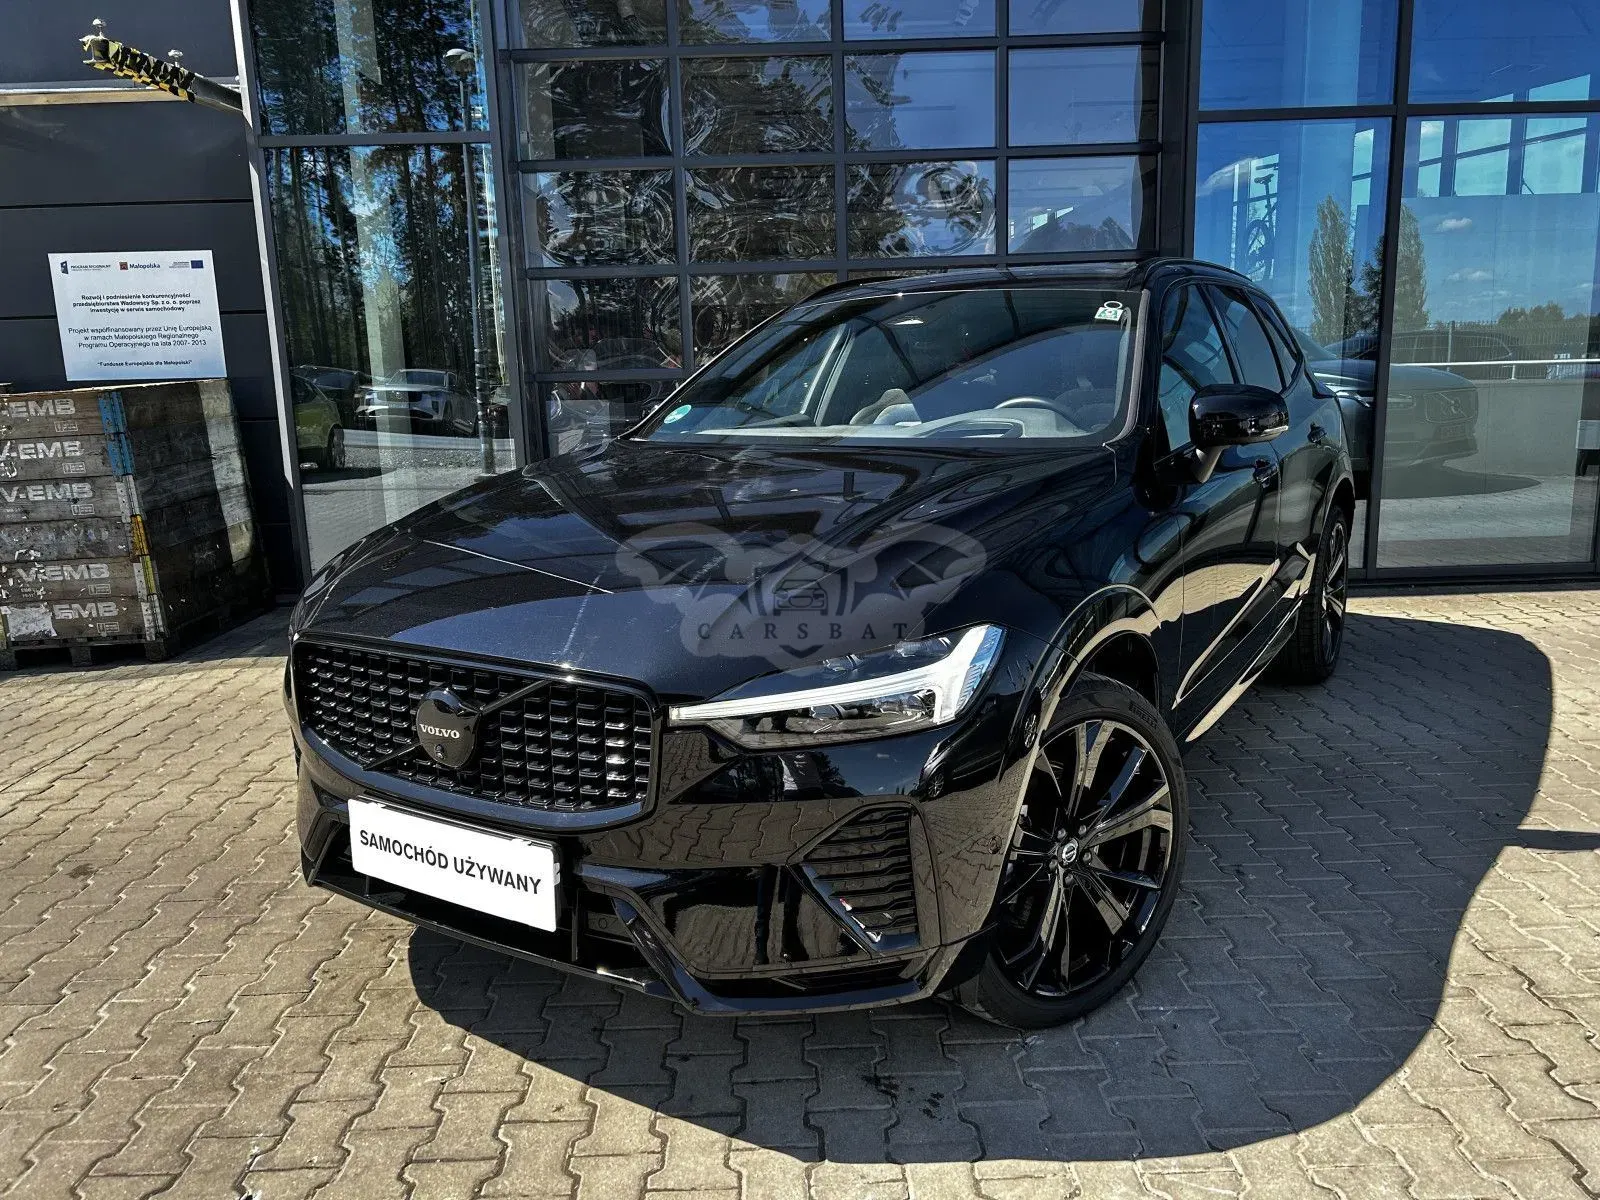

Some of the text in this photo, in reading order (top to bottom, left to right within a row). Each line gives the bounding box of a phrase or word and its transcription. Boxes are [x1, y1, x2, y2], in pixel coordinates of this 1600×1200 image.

[0, 399, 76, 418] -EMB
[53, 601, 119, 620] EMB
[419, 723, 460, 740] VOLVO
[359, 829, 542, 895] SAMOCHÓD UŻYWANY
